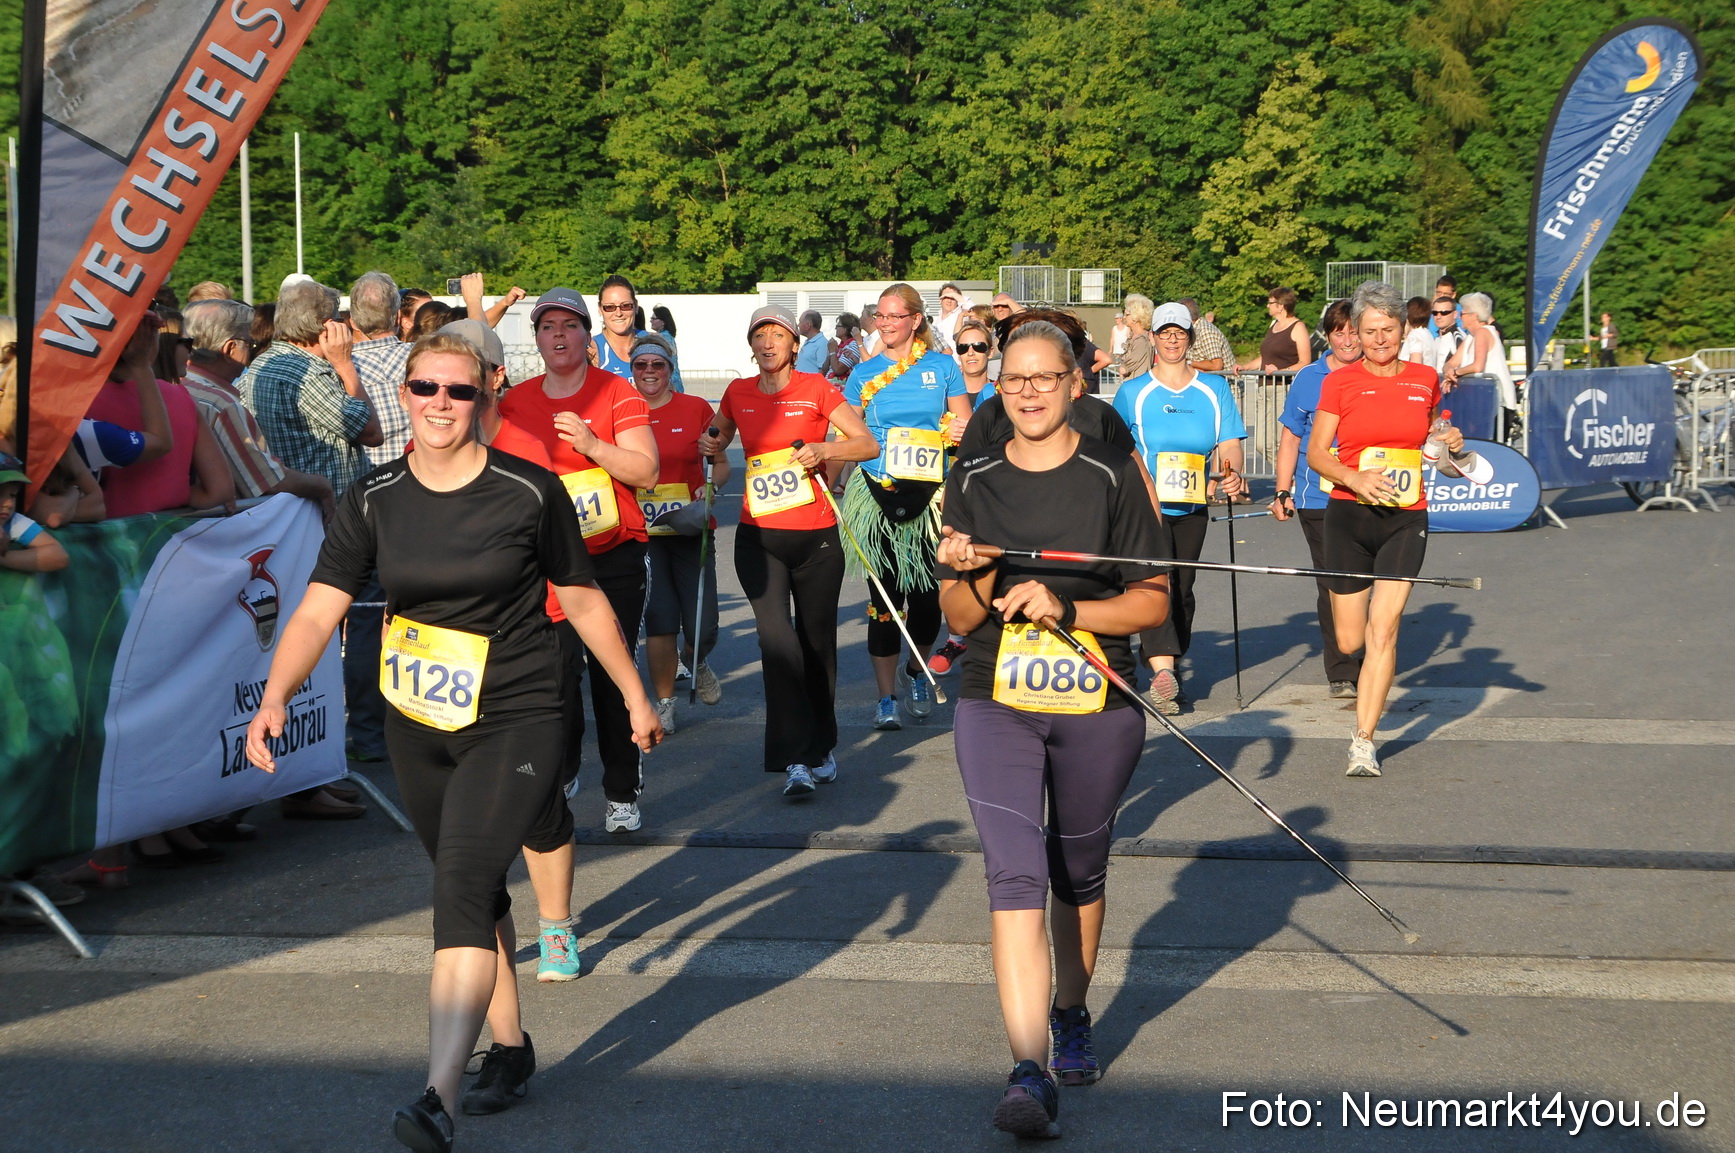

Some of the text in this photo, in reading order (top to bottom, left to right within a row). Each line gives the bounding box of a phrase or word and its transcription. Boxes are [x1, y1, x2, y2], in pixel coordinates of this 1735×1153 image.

[39, 0, 297, 356] WECHSELS
[1542, 95, 1652, 241] Frischmann
[1538, 217, 1603, 325] www.frischmann-net.de
[1582, 415, 1655, 449] Fischer
[889, 444, 940, 469] 1167
[1588, 451, 1648, 468] AUTOMOBILE
[375, 472, 393, 482] JAKO
[752, 470, 799, 501] 939
[1164, 469, 1197, 491] 481
[384, 653, 475, 709] 1128
[1002, 656, 1103, 694] 1086
[1023, 692, 1054, 700] Christiane
[1037, 700, 1060, 708] Wagner
